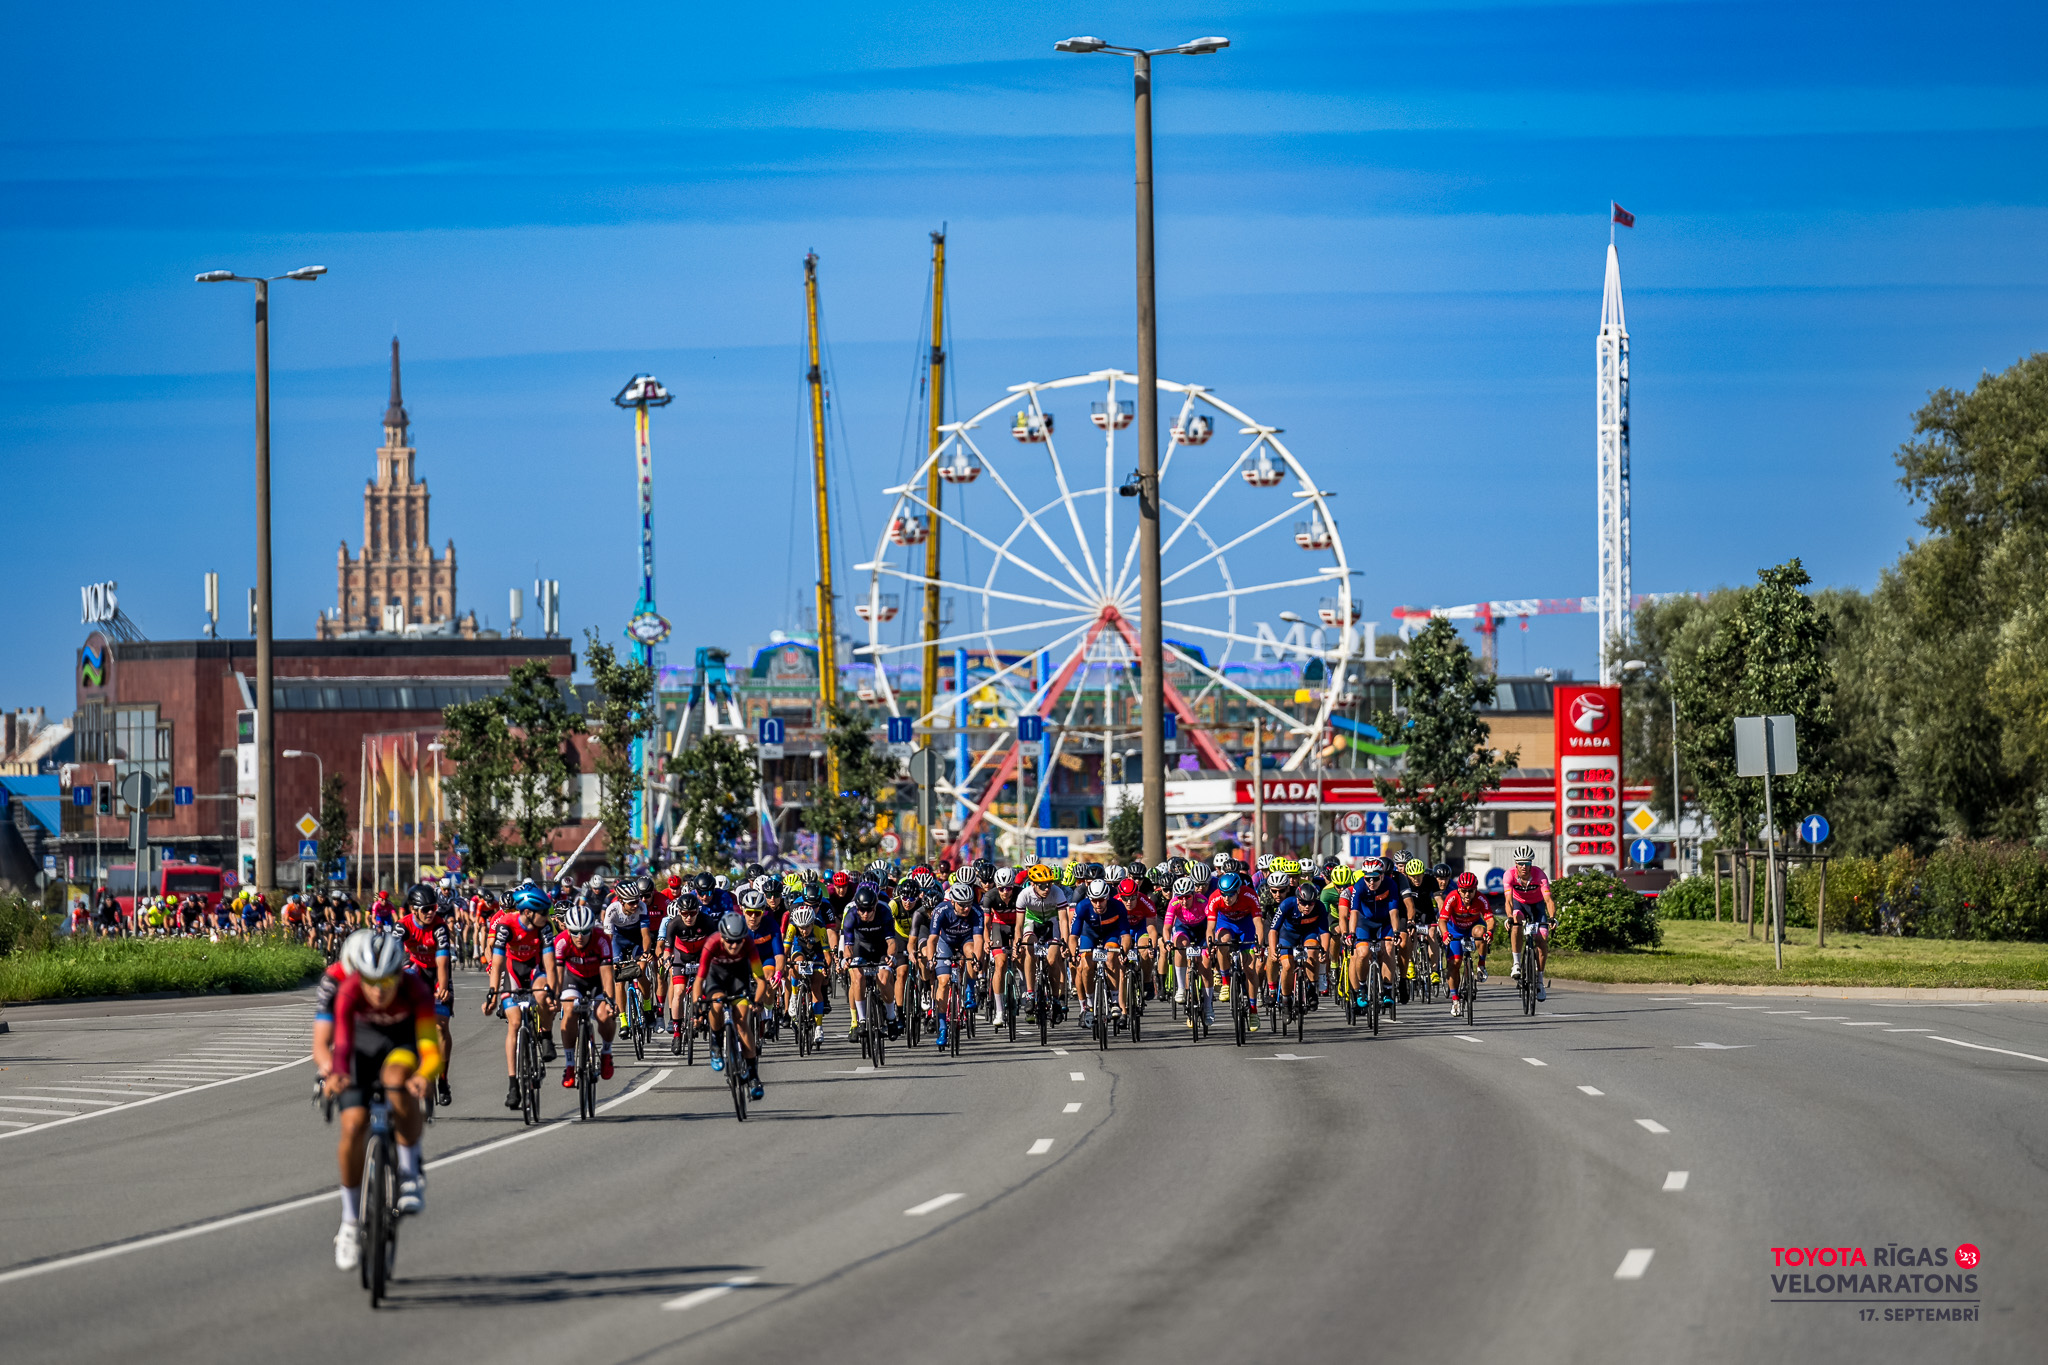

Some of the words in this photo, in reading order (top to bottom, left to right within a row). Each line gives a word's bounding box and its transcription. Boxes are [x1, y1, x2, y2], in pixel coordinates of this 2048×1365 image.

[81, 580, 118, 624] MOLS
[1569, 737, 1611, 747] VIADA
[1349, 816, 1360, 828] 50
[1271, 906, 1283, 928] Atom
[392, 923, 406, 938] RS
[434, 926, 449, 948] RRS
[494, 925, 510, 947] RRS
